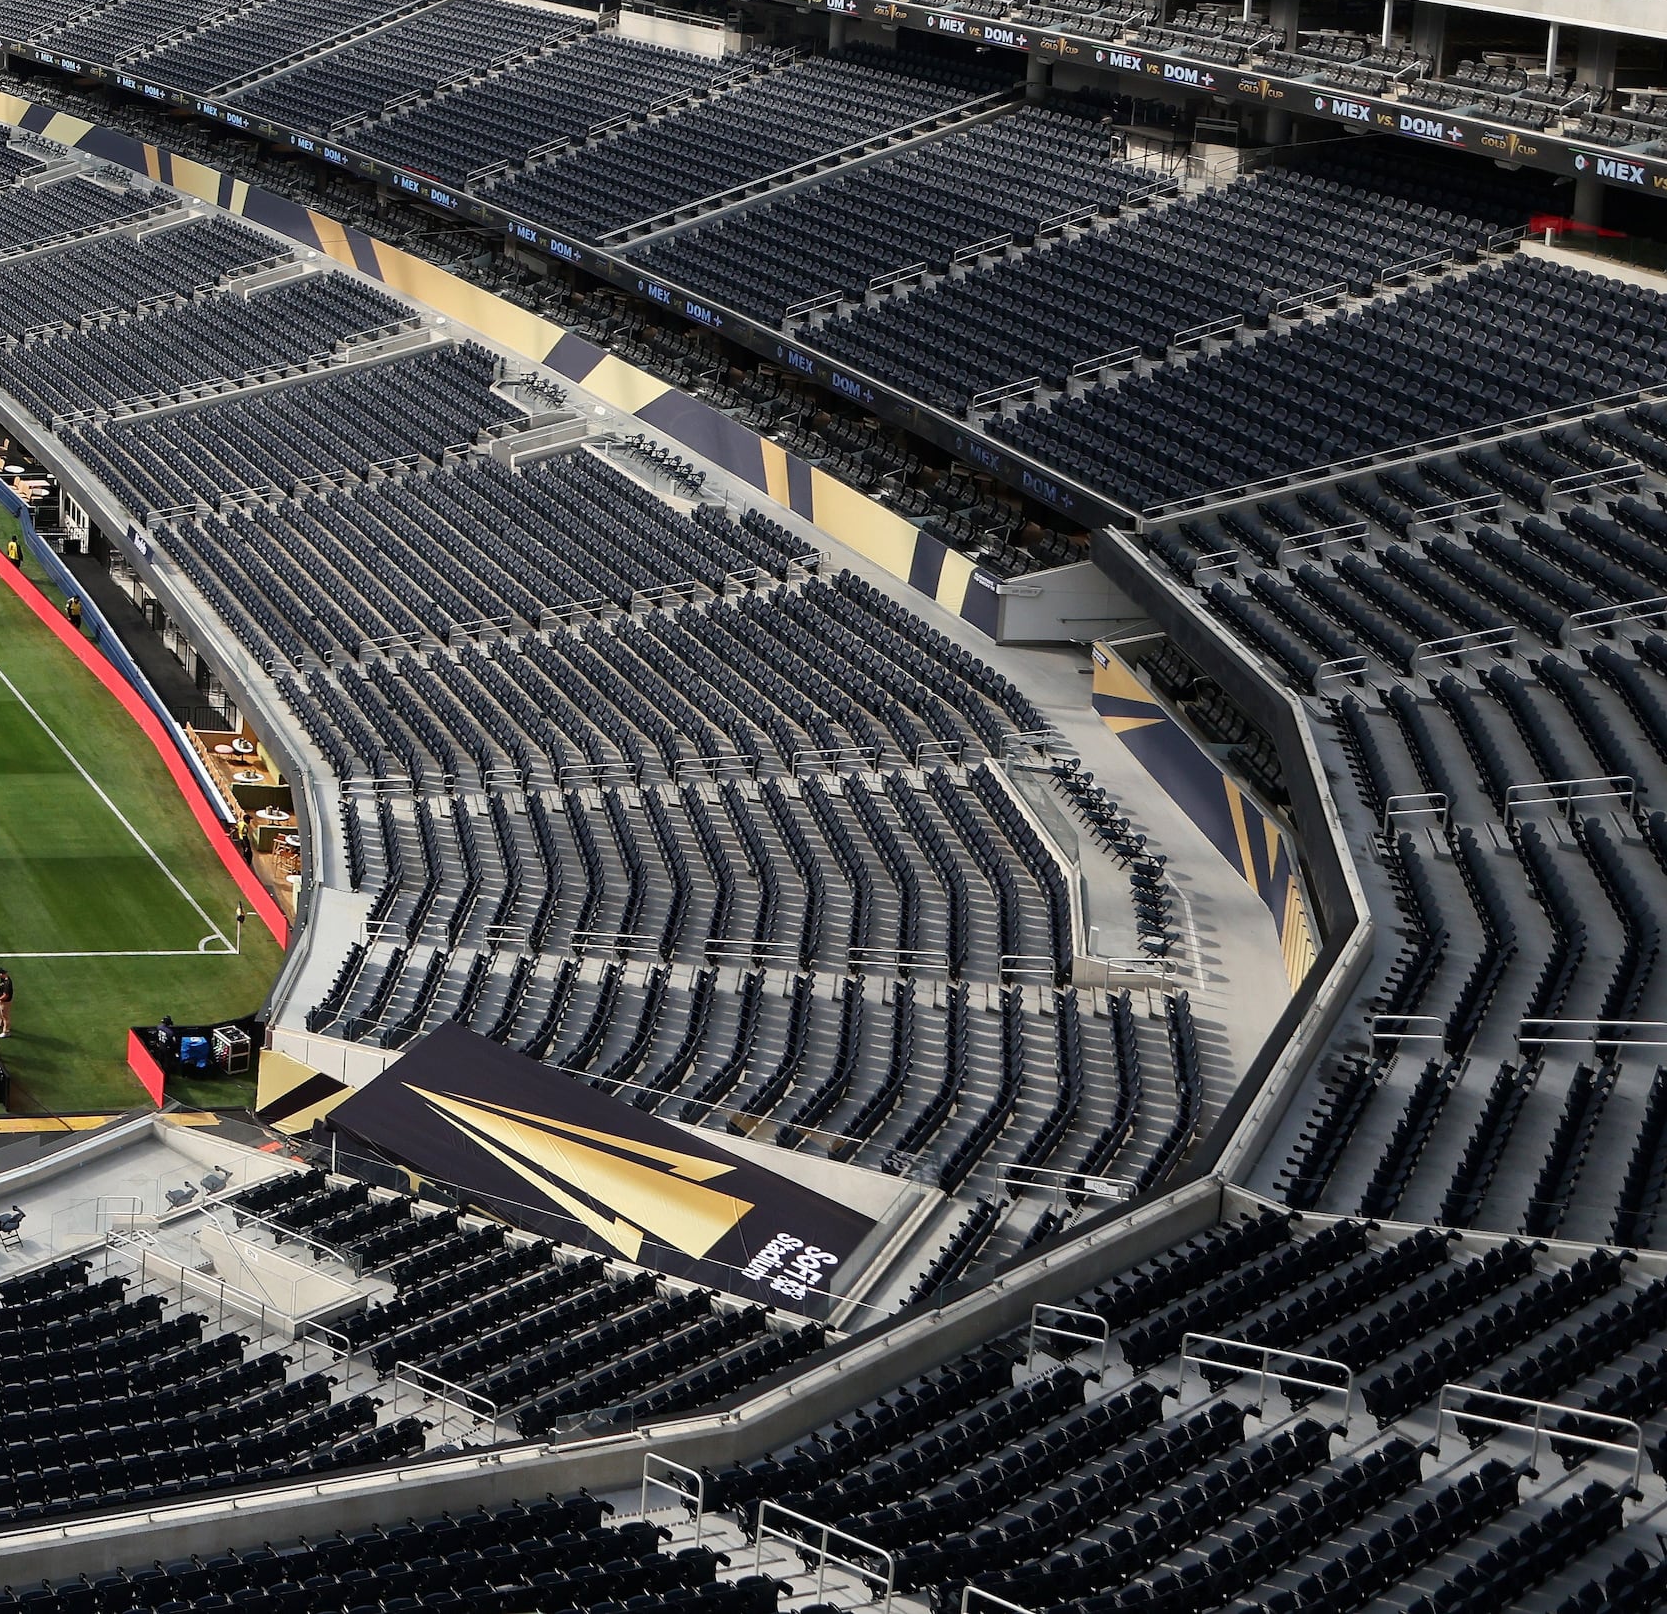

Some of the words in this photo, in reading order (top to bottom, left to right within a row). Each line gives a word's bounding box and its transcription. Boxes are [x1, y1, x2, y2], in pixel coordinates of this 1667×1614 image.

[939, 17, 966, 35] MEX
[984, 26, 1014, 44] DOM
[1109, 51, 1142, 72] MEX
[1163, 63, 1199, 85] DOM
[1332, 99, 1371, 122] MEX
[1399, 113, 1444, 139] DOM
[1596, 159, 1645, 185] MEX
[648, 285, 671, 305] MEX
[685, 300, 712, 323] DOM
[788, 350, 814, 376] MEX
[832, 371, 861, 399] DOM
[741, 1232, 804, 1281] Stadium
[783, 1245, 838, 1285] SoFi
